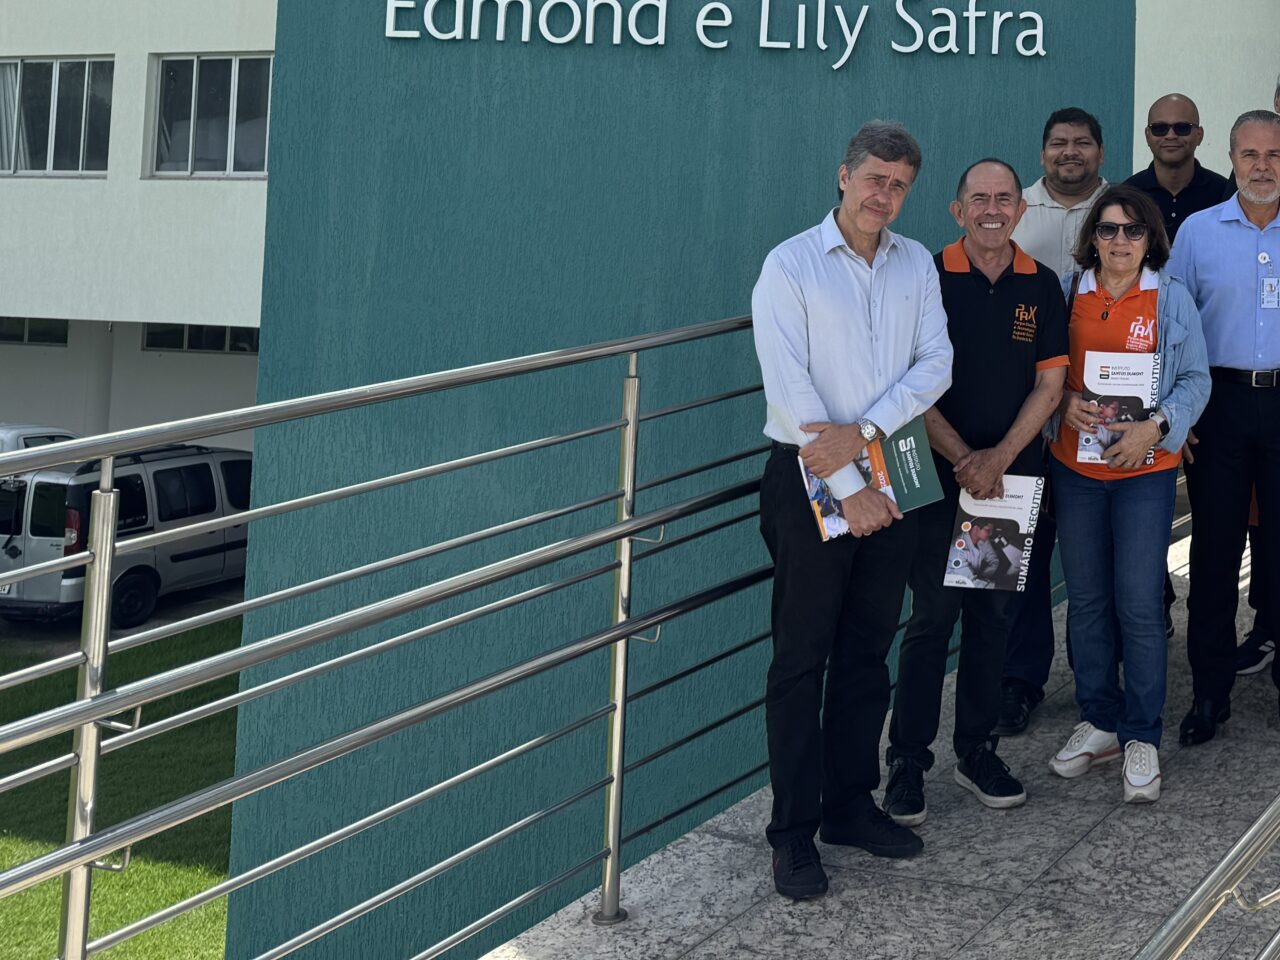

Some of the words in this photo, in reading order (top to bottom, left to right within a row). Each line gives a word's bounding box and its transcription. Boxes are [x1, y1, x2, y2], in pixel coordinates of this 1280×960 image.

[695, 1, 733, 49] e
[1150, 353, 1160, 408] EXECUTIVO
[1016, 538, 1034, 592] SUMÁRIO
[1027, 476, 1044, 534] EXECUTIVO
